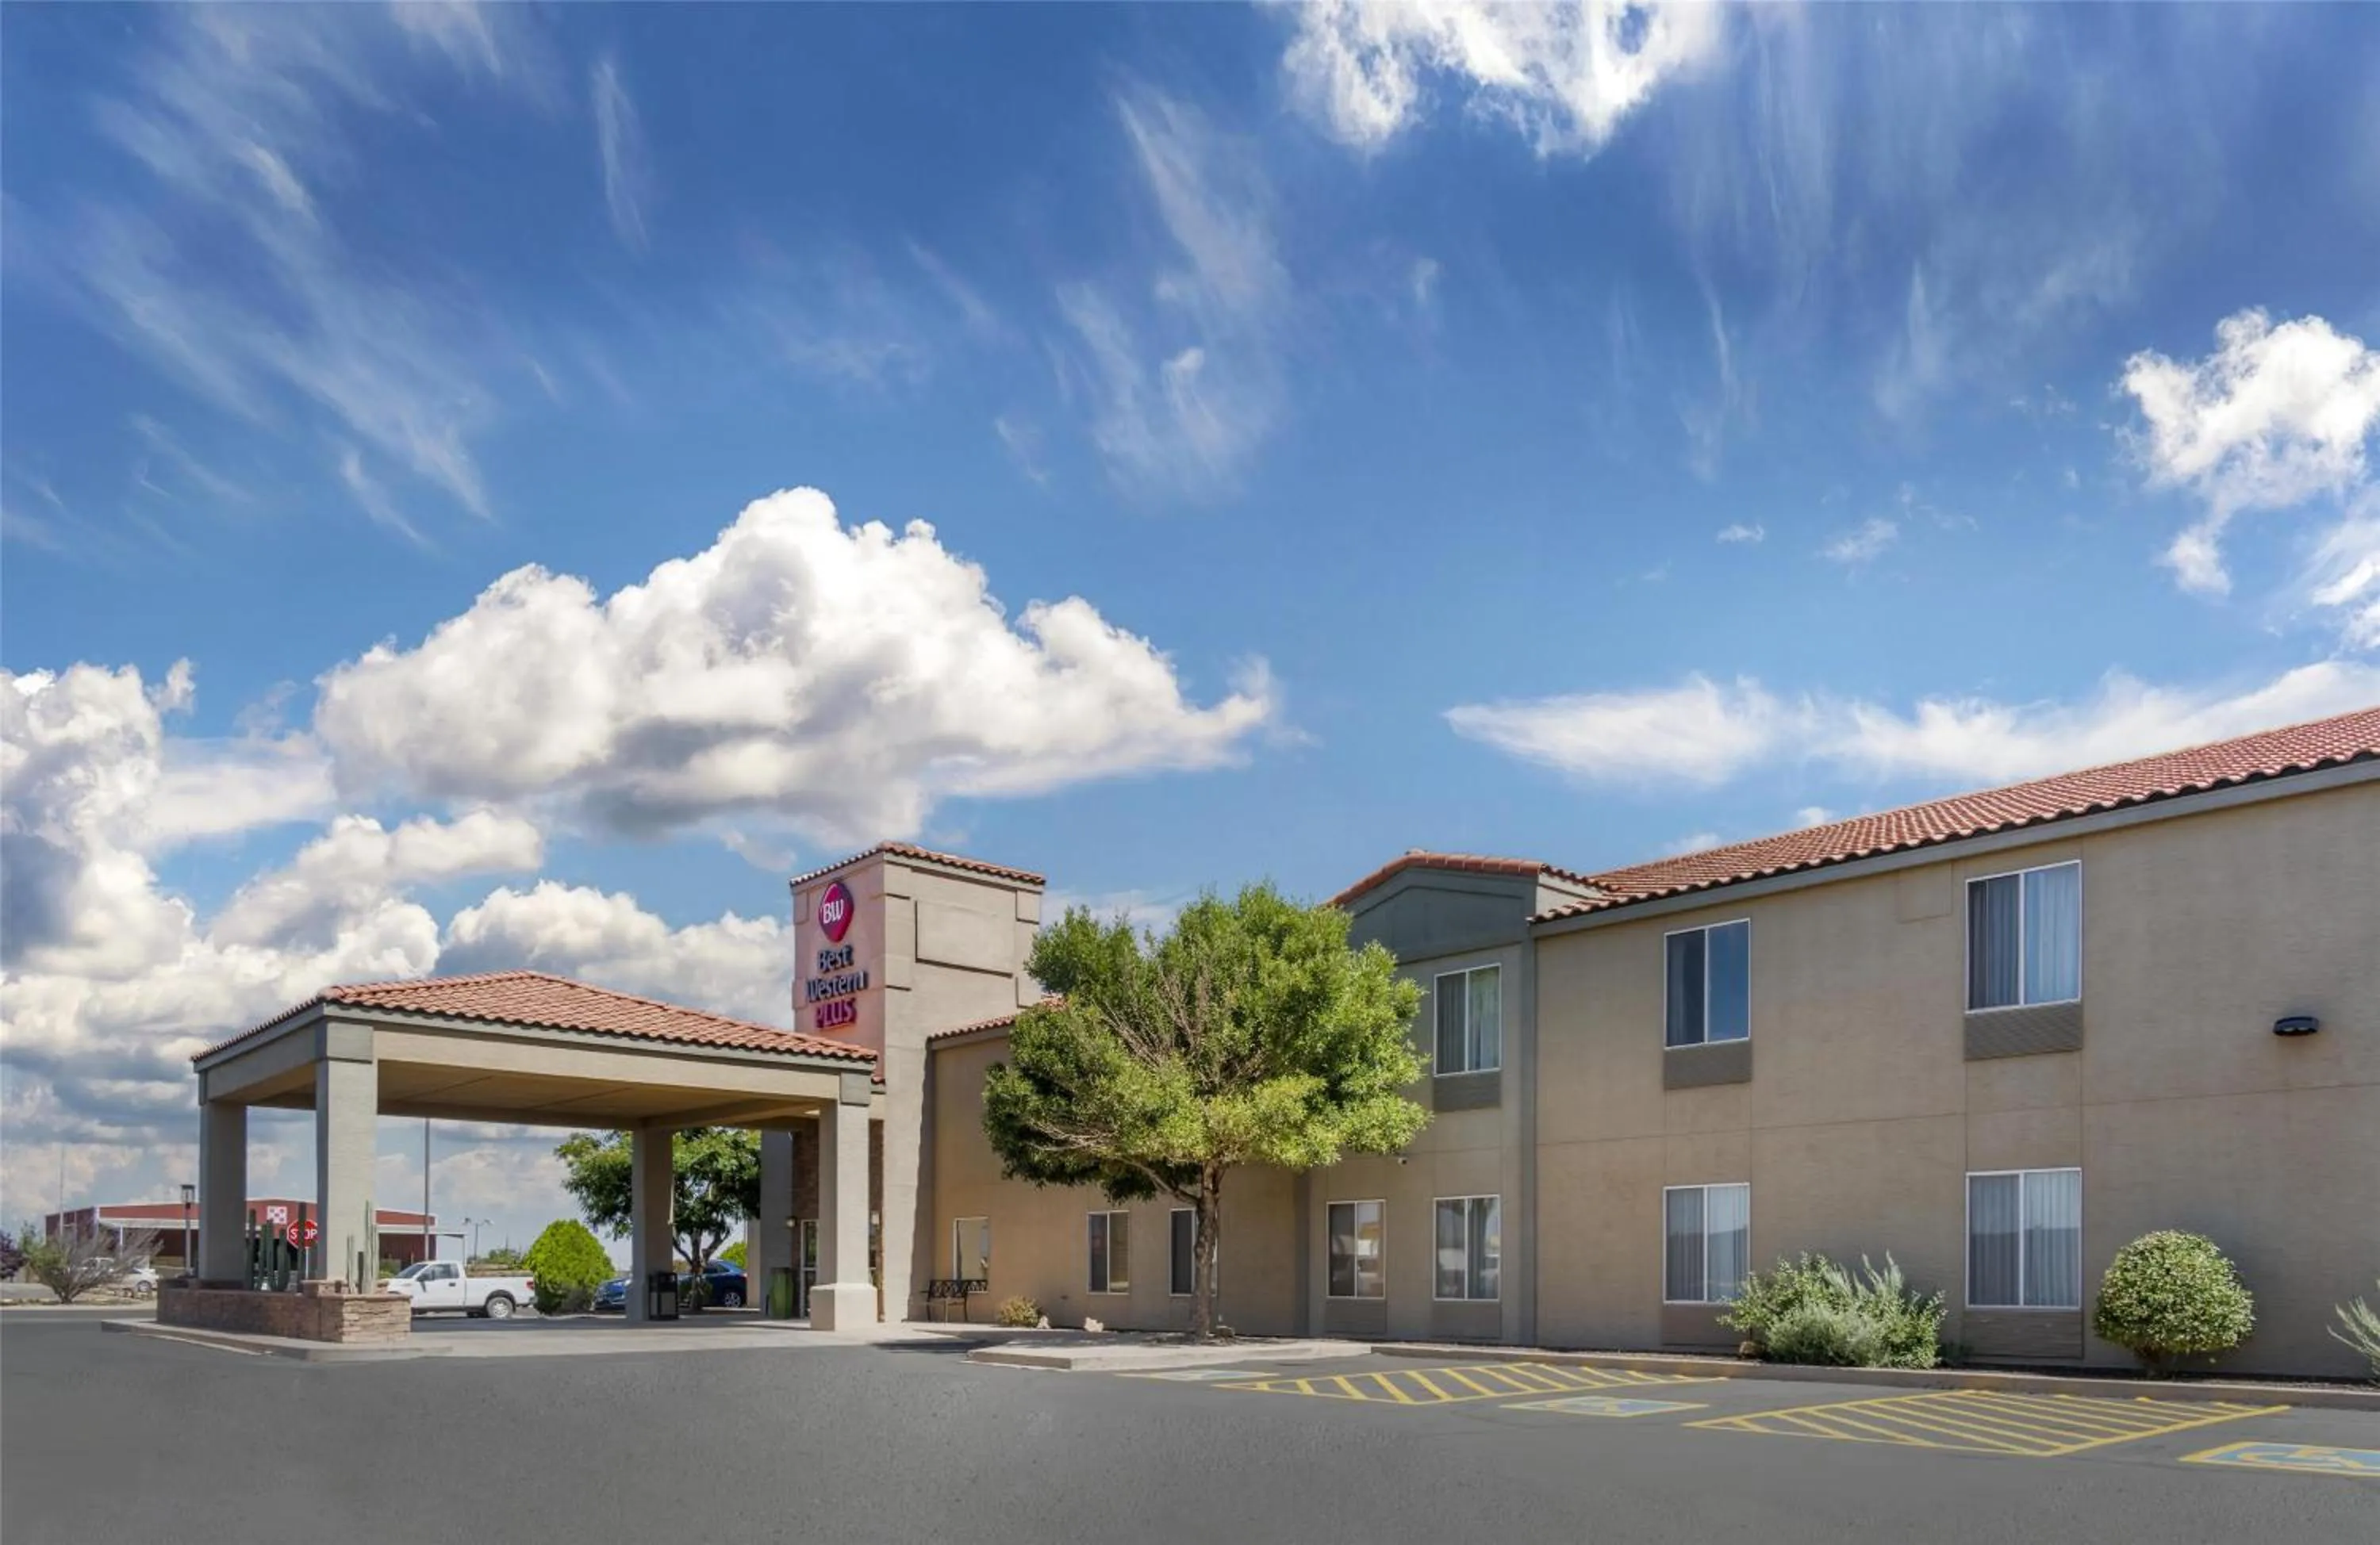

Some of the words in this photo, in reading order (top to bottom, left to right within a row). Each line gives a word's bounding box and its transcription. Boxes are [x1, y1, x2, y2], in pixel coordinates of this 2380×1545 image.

[823, 899, 844, 923] BW
[818, 945, 854, 972] Best
[807, 972, 867, 1003] Western
[816, 999, 856, 1028] PLUS
[290, 1229, 317, 1239] SOP
